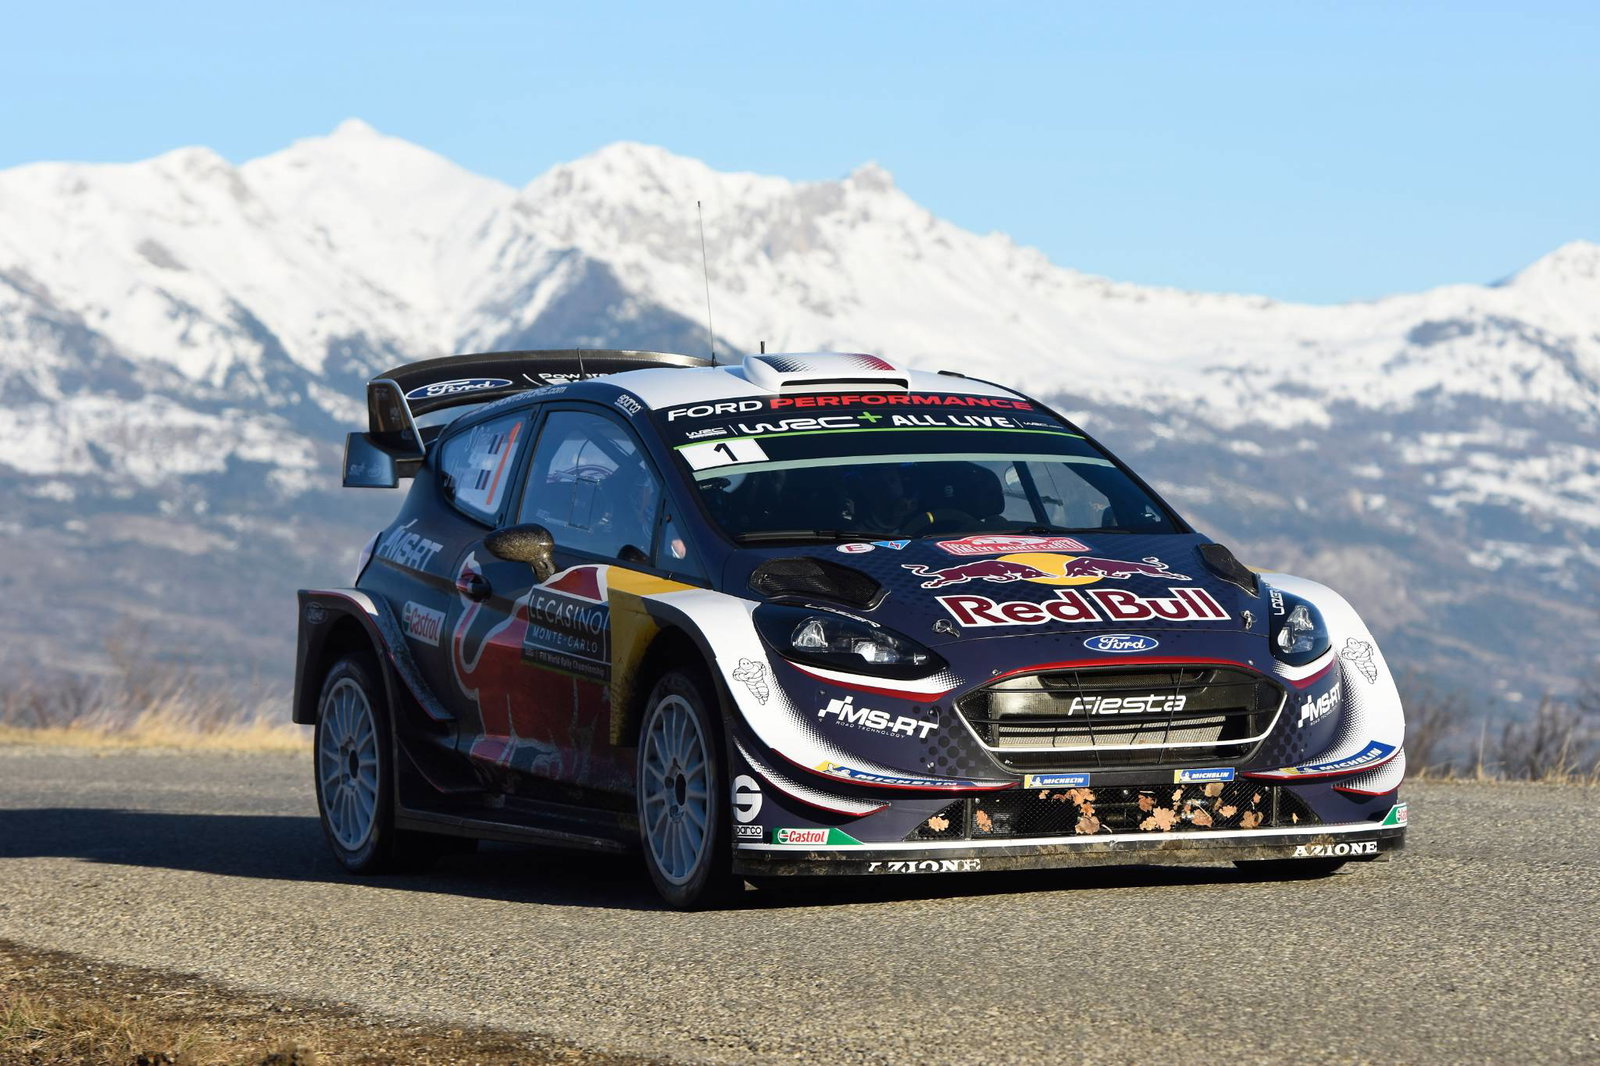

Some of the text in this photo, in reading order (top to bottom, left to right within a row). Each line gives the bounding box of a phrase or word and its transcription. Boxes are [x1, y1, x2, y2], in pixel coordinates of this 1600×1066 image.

[426, 380, 495, 397] Ford
[667, 395, 1034, 422] FORD PERFORMANCE
[892, 414, 946, 426] ALL
[948, 415, 1014, 428] LIVE
[713, 442, 738, 462] 1
[545, 599, 602, 635] CASINO
[937, 587, 1232, 627] Red Bull
[409, 607, 442, 642] Castrol
[533, 626, 598, 653] MONTE-CARLO
[1097, 636, 1146, 650] Ford
[1068, 694, 1187, 716] Fiesta
[838, 703, 939, 738] MS-RT
[1319, 747, 1383, 771] MICHELIN
[853, 773, 958, 787] MICHELIN
[1042, 776, 1084, 785] MICHELIN
[1191, 771, 1230, 780] MICHELIN
[789, 830, 826, 843] Castrol
[1292, 841, 1378, 856] AZIONE
